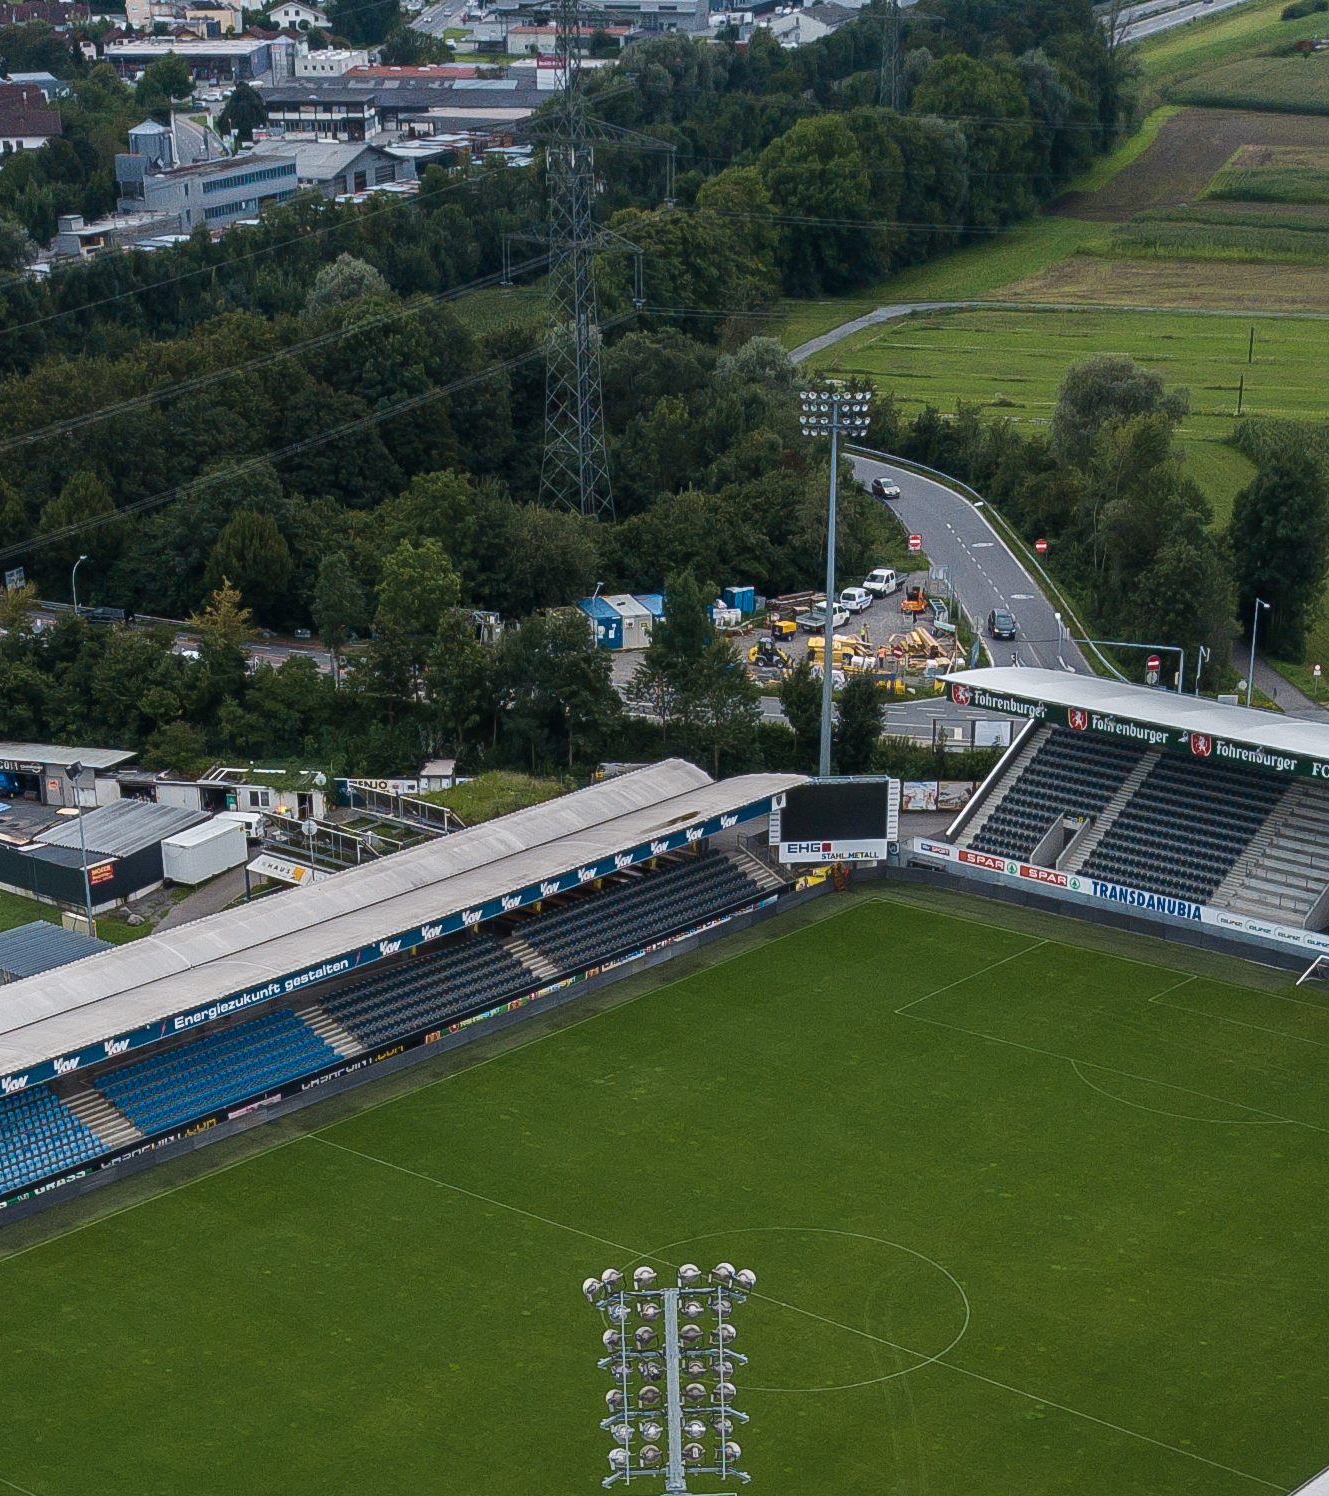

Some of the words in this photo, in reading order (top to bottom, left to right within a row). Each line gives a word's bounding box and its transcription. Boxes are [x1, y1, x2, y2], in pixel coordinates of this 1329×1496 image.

[974, 688, 1047, 720] Fohrenburger
[1216, 740, 1297, 772] Fohrenburger
[787, 843, 821, 854] EHG
[967, 853, 1005, 871] SPAR
[1029, 868, 1067, 887] SPAR
[1092, 880, 1203, 921] TRANSDANUBIA
[174, 982, 281, 1030] Energiezukunft
[285, 958, 349, 993] gestalten
